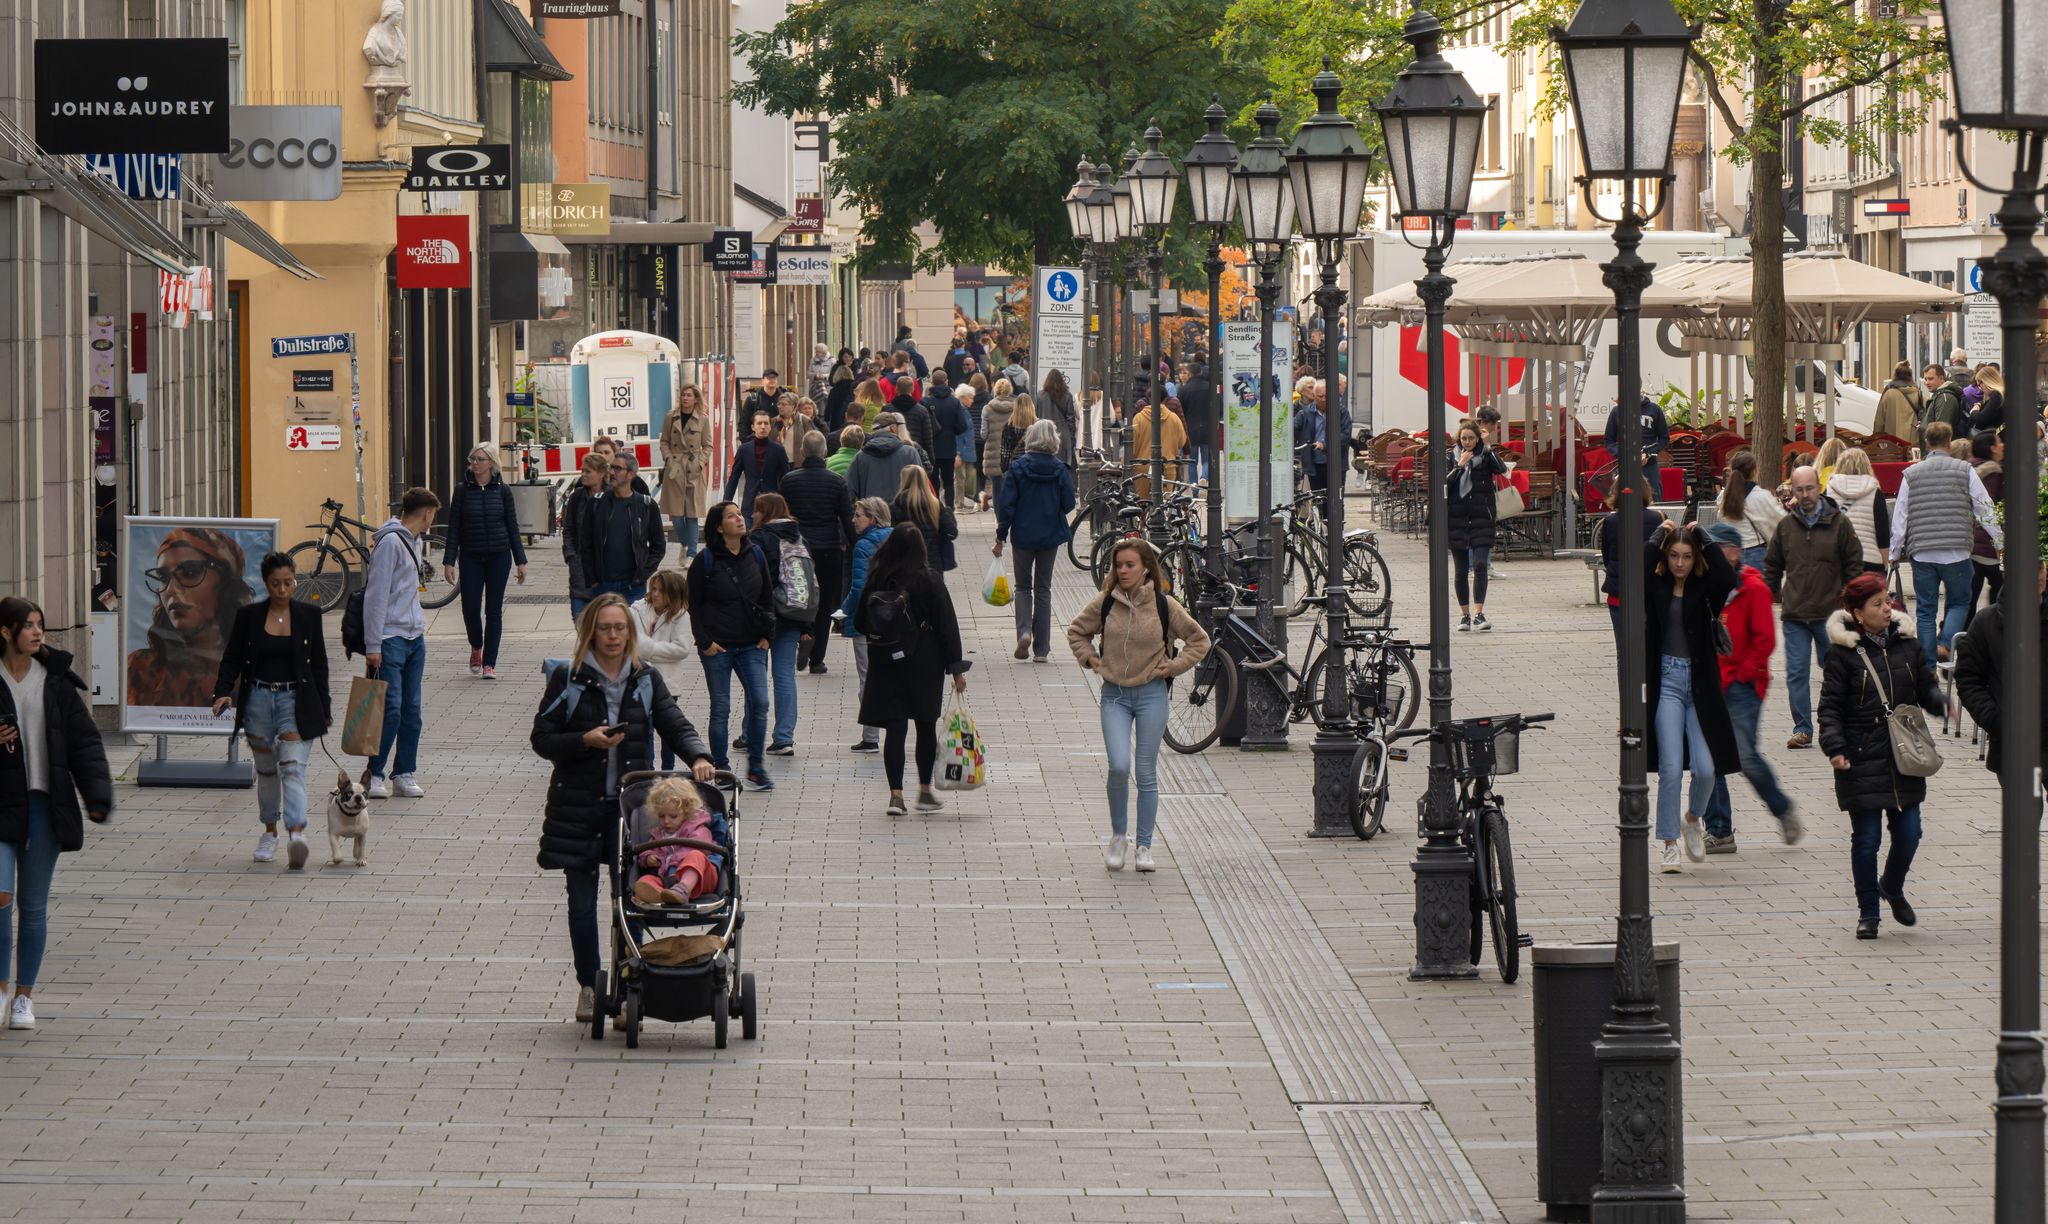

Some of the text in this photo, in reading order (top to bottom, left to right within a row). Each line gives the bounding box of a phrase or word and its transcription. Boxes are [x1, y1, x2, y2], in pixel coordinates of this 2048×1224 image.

[542, 2, 609, 15] Trauringhaus
[51, 100, 215, 117] JOHN&AUDREY
[218, 137, 337, 169] ecco
[411, 174, 507, 187] OAKLEY
[546, 205, 604, 220] DRICH
[798, 203, 808, 215] Ji
[1839, 194, 1847, 221] TERREX
[795, 216, 819, 229] Gong
[1407, 216, 1425, 229] JBL
[421, 239, 441, 248] THE
[406, 247, 441, 256] NORTH
[416, 256, 441, 264] FACE
[777, 257, 829, 271] eSales
[655, 256, 664, 291] GRANIT
[1973, 294, 1993, 302] ZONE
[1050, 303, 1073, 312] ZONE
[278, 336, 344, 354] Dultstraße
[610, 386, 631, 397] TOI
[611, 397, 631, 408] TOI
[1591, 403, 1611, 415] del
[159, 713, 237, 721] CAROLINA HERRERA
